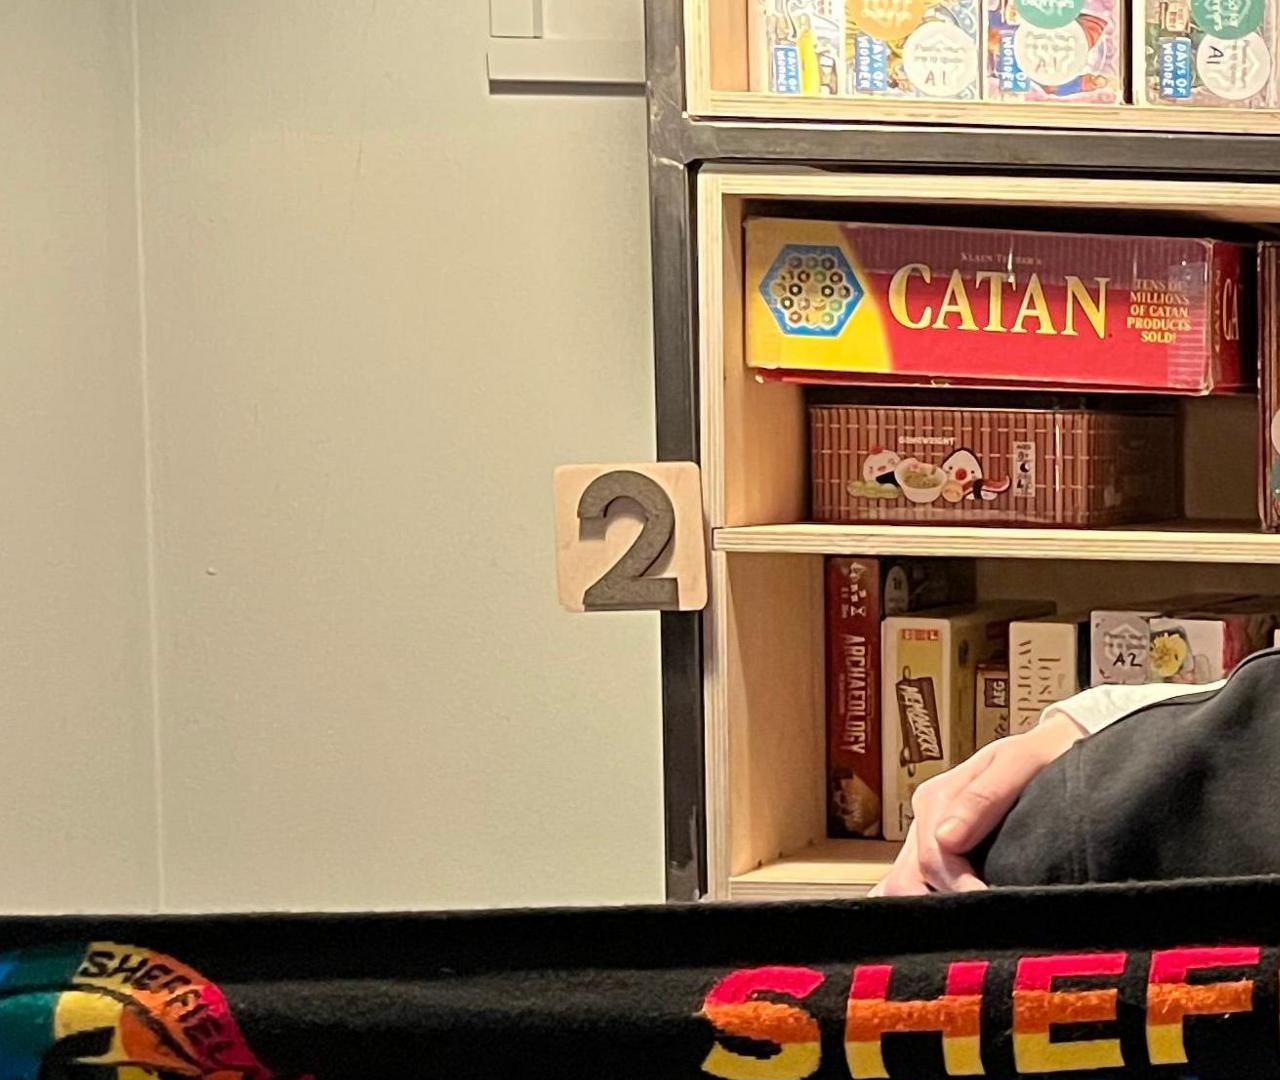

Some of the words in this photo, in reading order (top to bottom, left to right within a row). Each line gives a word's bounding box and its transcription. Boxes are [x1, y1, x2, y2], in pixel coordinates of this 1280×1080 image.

[857, 35, 870, 90] WONDER
[1000, 38, 1013, 89] WONDER
[1162, 44, 1173, 96] WONDER
[1175, 43, 1186, 73] DAYS
[1175, 77, 1186, 95] OF
[1130, 292, 1190, 305] MILLIONS
[1136, 278, 1164, 291] TENS
[888, 263, 1110, 340] CATAN
[1130, 304, 1147, 316] OF
[1149, 305, 1189, 318] CATAN
[1127, 317, 1191, 331] PRODUCTS
[1141, 330, 1176, 343] SOLD!
[577, 470, 679, 611] 2
[1112, 651, 1143, 668] A2
[841, 634, 866, 755] ARCHAEOLOGY
[990, 679, 1007, 707] AEG
